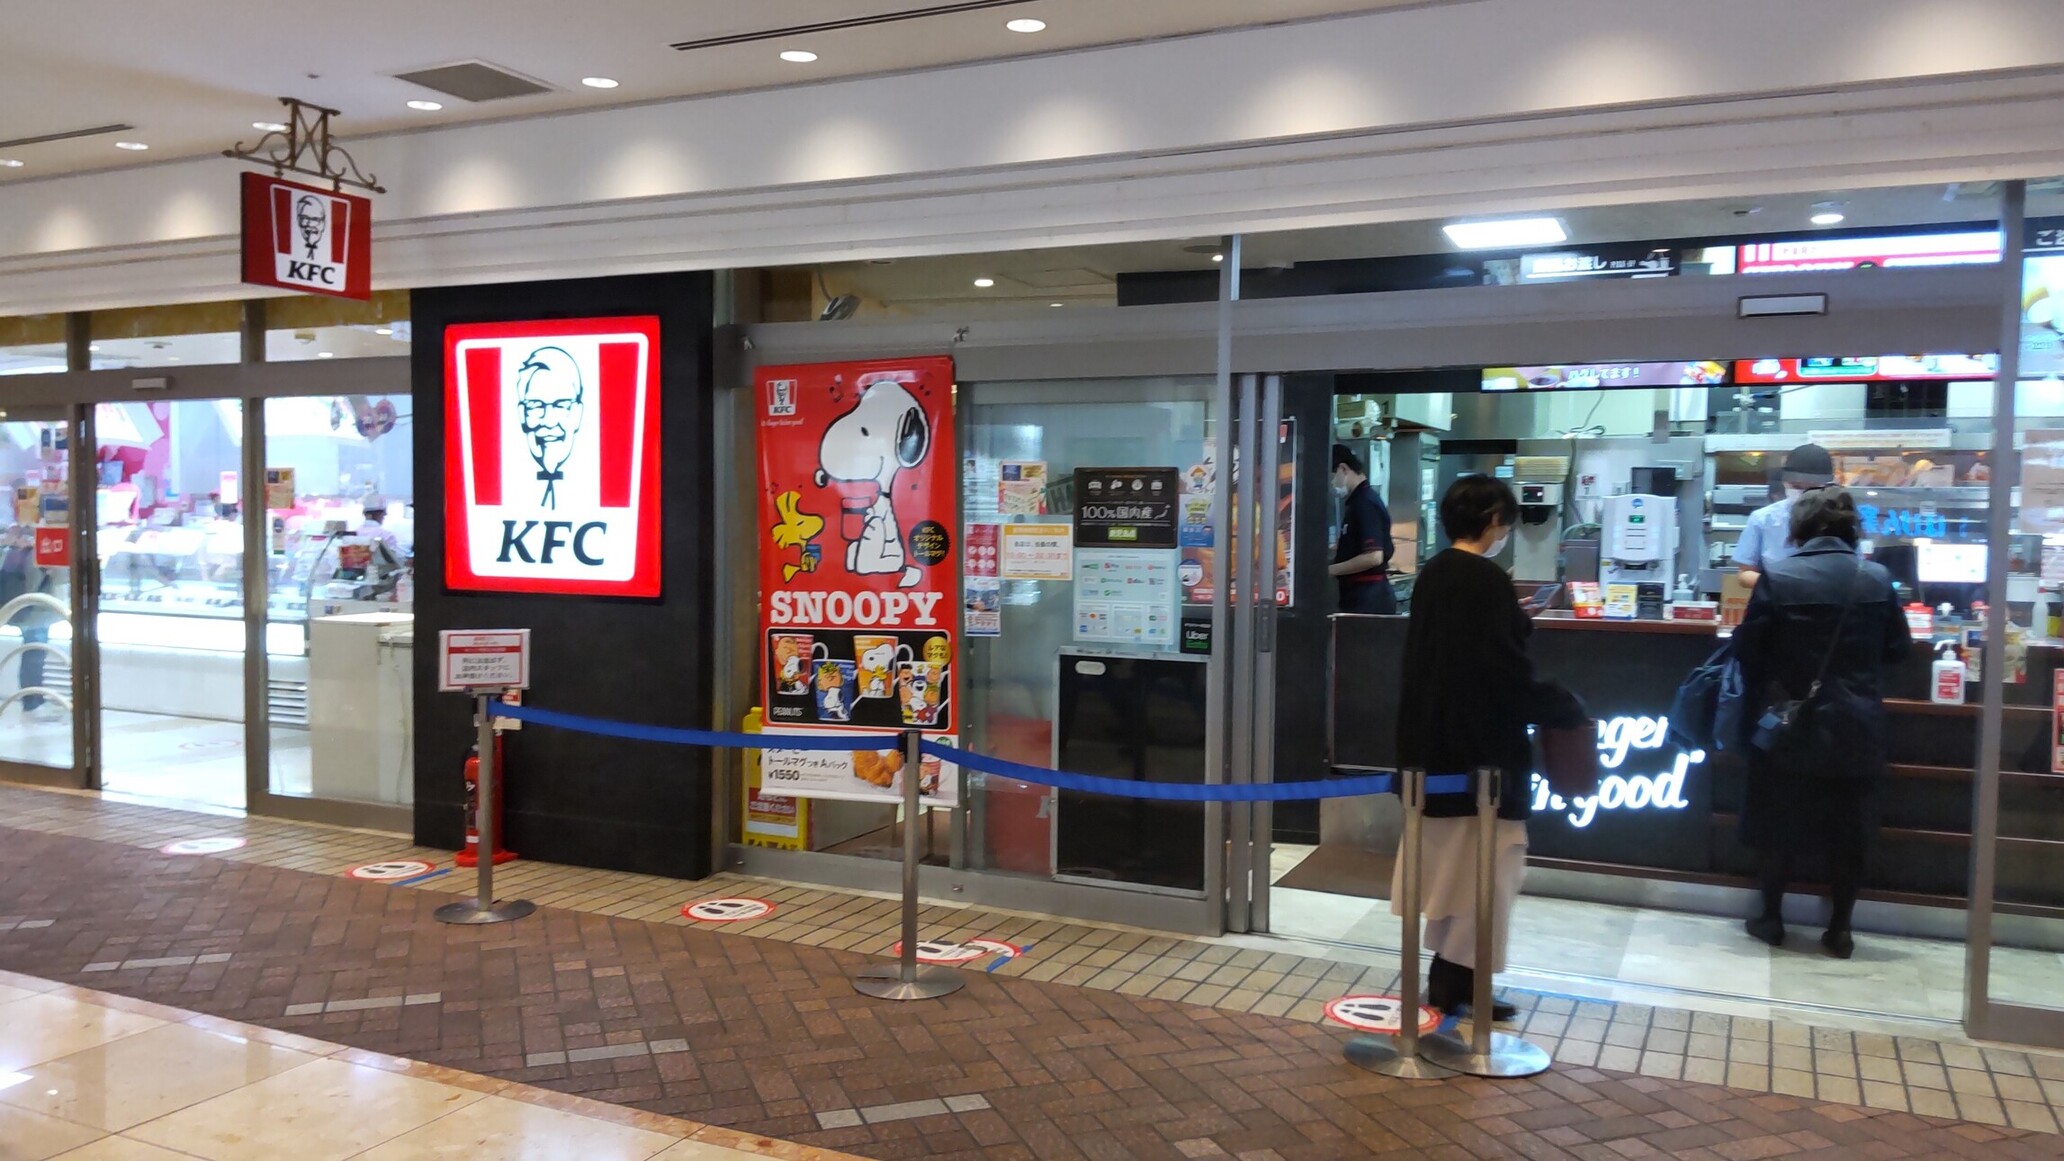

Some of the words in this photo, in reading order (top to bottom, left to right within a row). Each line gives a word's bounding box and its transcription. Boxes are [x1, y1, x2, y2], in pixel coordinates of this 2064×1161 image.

[287, 260, 335, 284] KFC
[772, 405, 792, 413] KFC
[496, 519, 608, 567] KFC
[770, 590, 943, 625] SNOOPY
[1185, 630, 1208, 640] Uber
